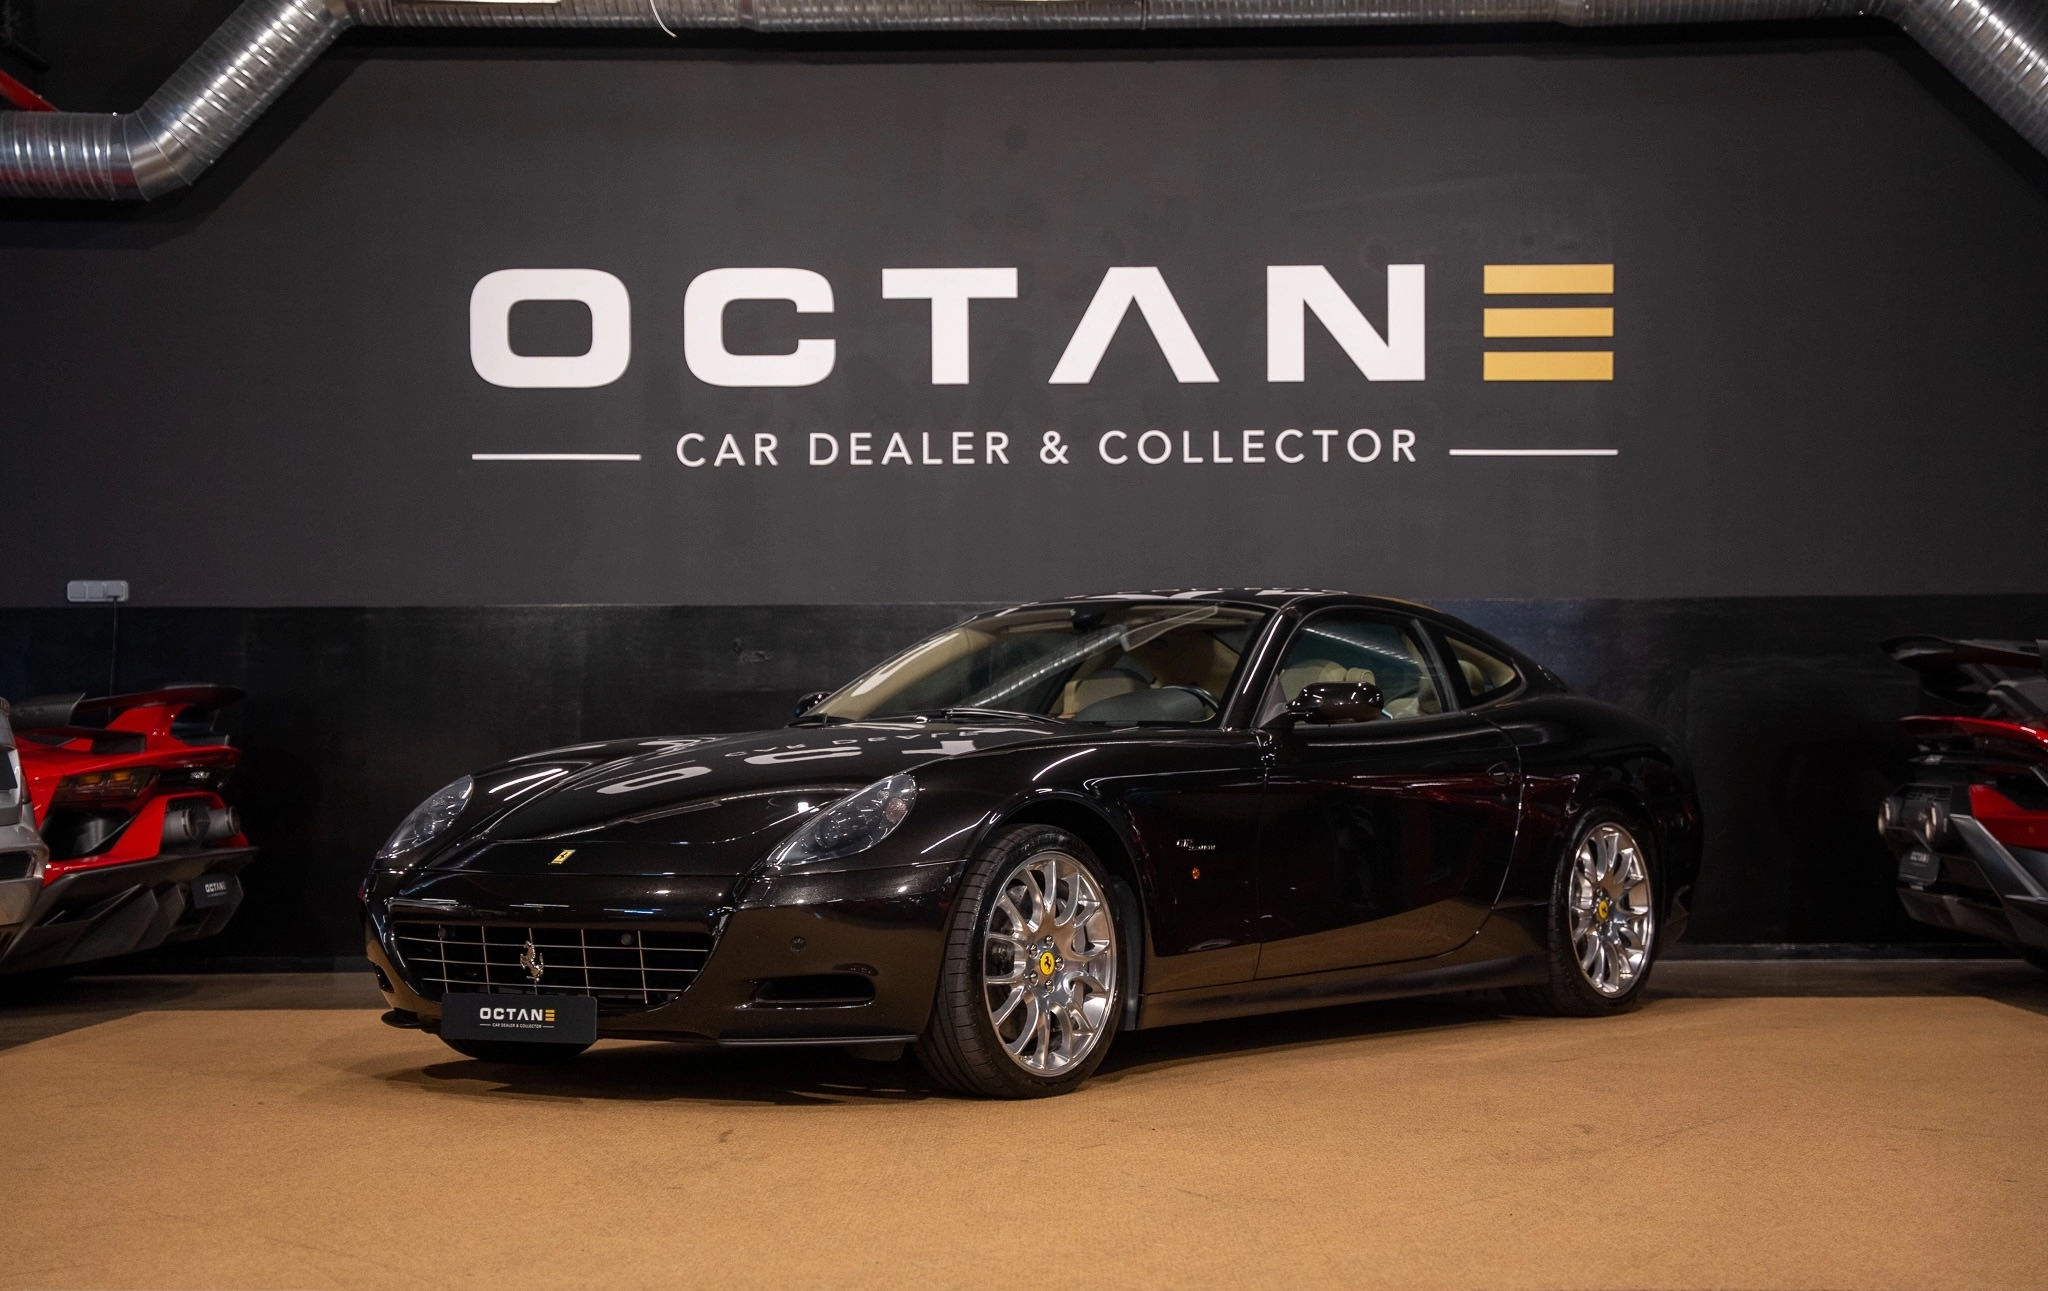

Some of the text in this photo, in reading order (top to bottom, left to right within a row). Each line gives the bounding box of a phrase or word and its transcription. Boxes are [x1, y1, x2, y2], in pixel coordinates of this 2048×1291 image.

[469, 263, 1615, 389] OCTANE
[676, 428, 1416, 468] CAR DEALER & COLLECTOR
[479, 1007, 555, 1022] OCTANE
